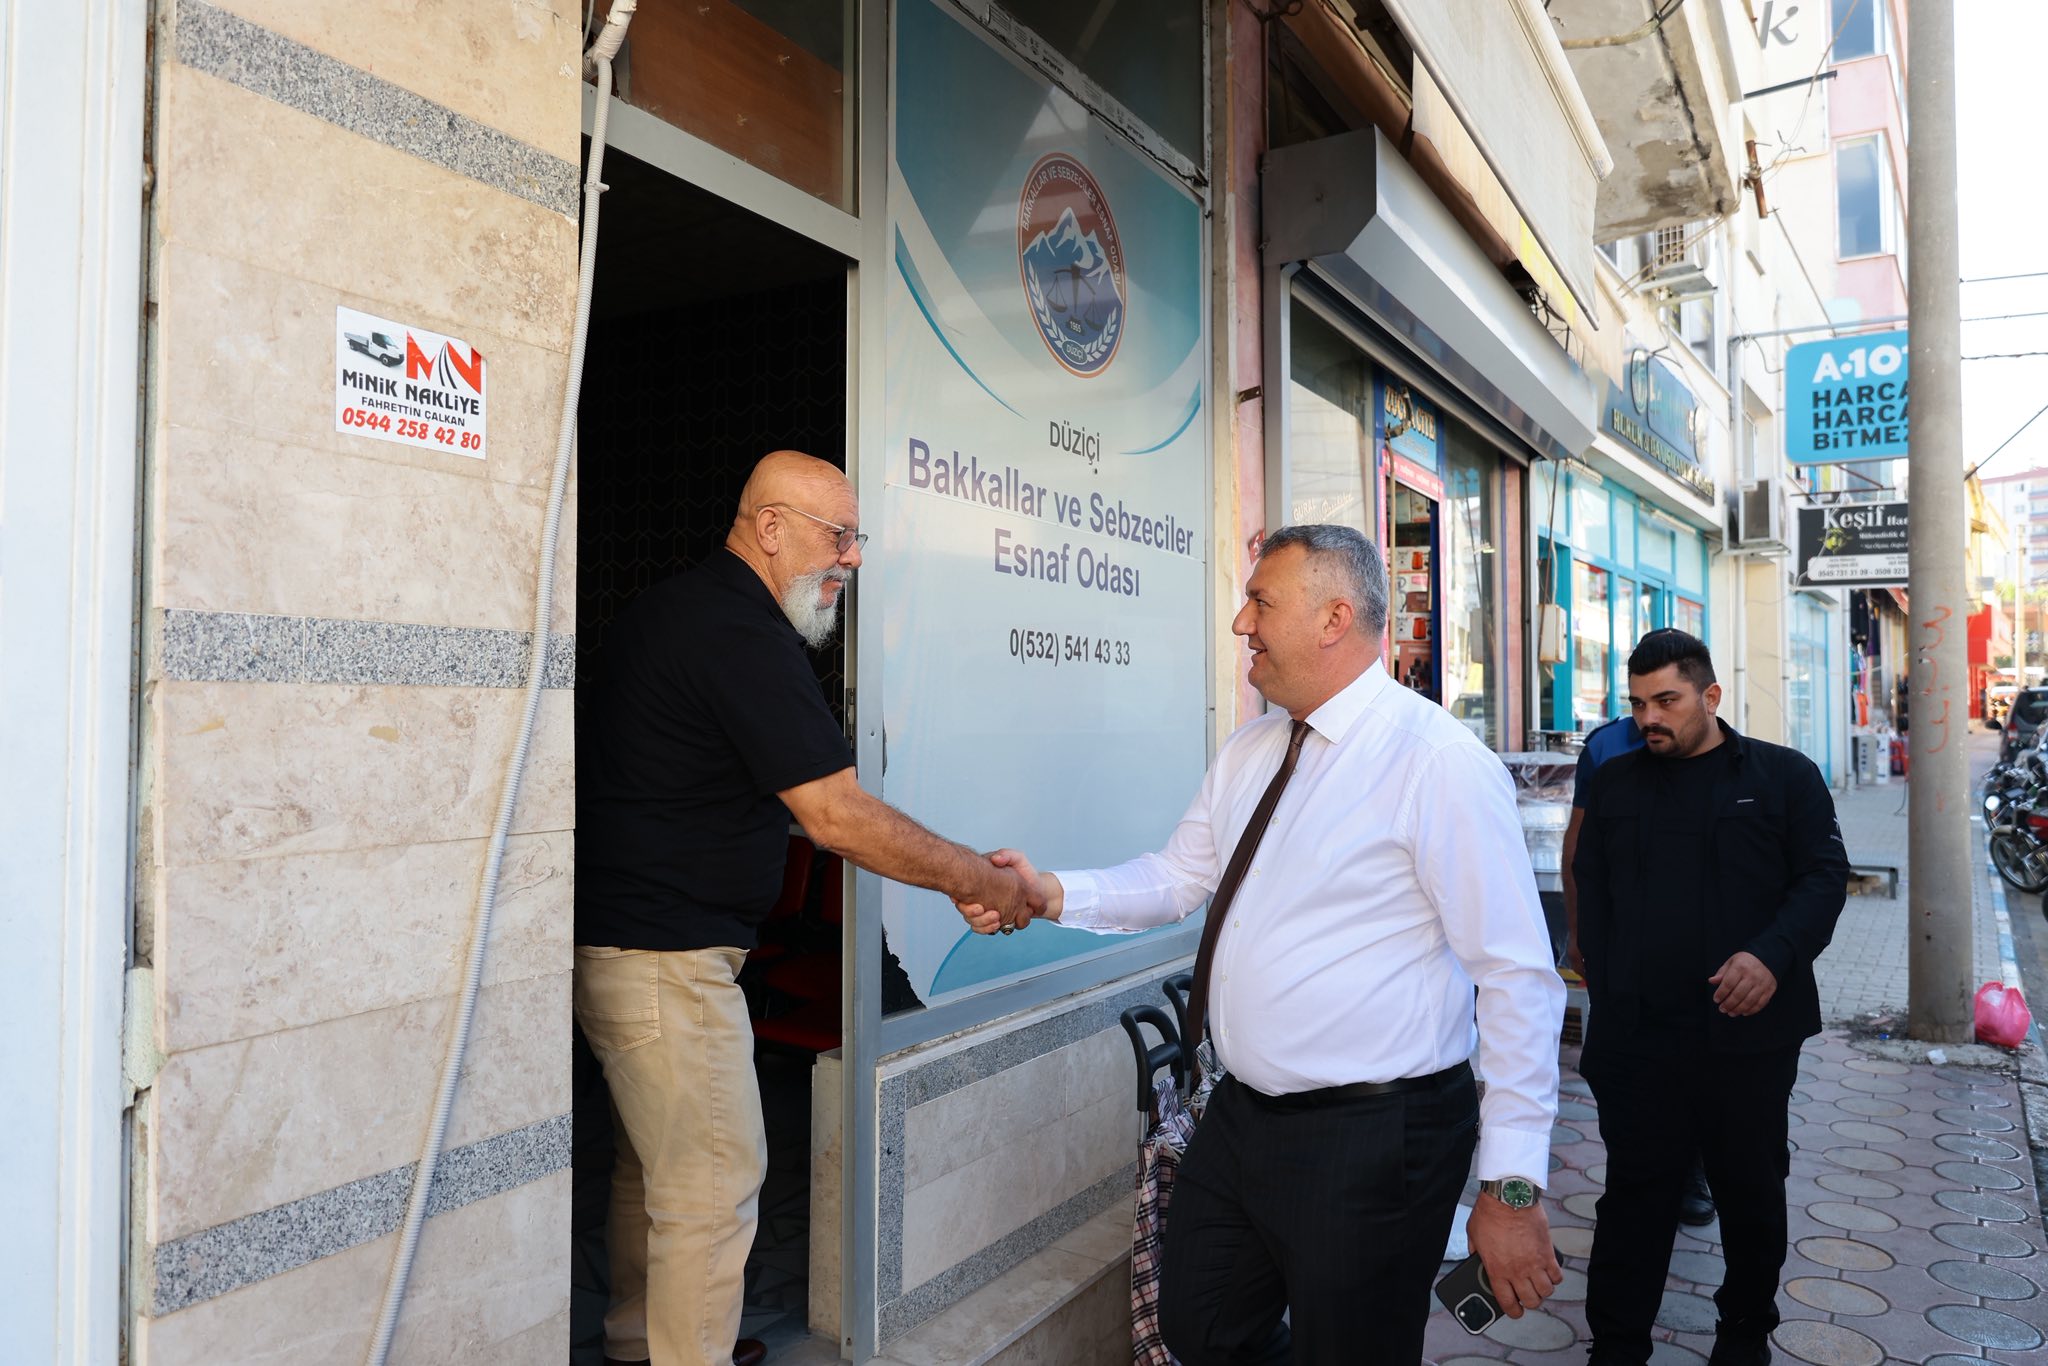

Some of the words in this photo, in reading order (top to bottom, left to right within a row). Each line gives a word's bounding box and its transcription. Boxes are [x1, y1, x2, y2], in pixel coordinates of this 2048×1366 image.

[1022, 170, 1048, 231] BAKKALLAR
[1096, 203, 1113, 242] ESNAF
[1110, 245, 1121, 285] ODASI
[342, 407, 391, 433] 0544
[396, 418, 429, 440] 258
[434, 426, 456, 446] 42
[460, 432, 482, 451] 80
[361, 396, 421, 418] FAHRETTİN
[424, 410, 466, 427] ÇALKAN
[1050, 420, 1100, 465] DÜZİÇİ
[909, 437, 1047, 518] Bakkallar
[1054, 490, 1082, 527] ve
[1089, 491, 1194, 556] Sebzeciler
[1824, 505, 1886, 531] Keşif
[994, 527, 1070, 584] Esnaf
[1076, 547, 1140, 597] Odası
[1009, 628, 1060, 667] 0(532)
[1064, 634, 1089, 662] 541
[1094, 637, 1111, 666] 43
[1114, 640, 1131, 666] 33
